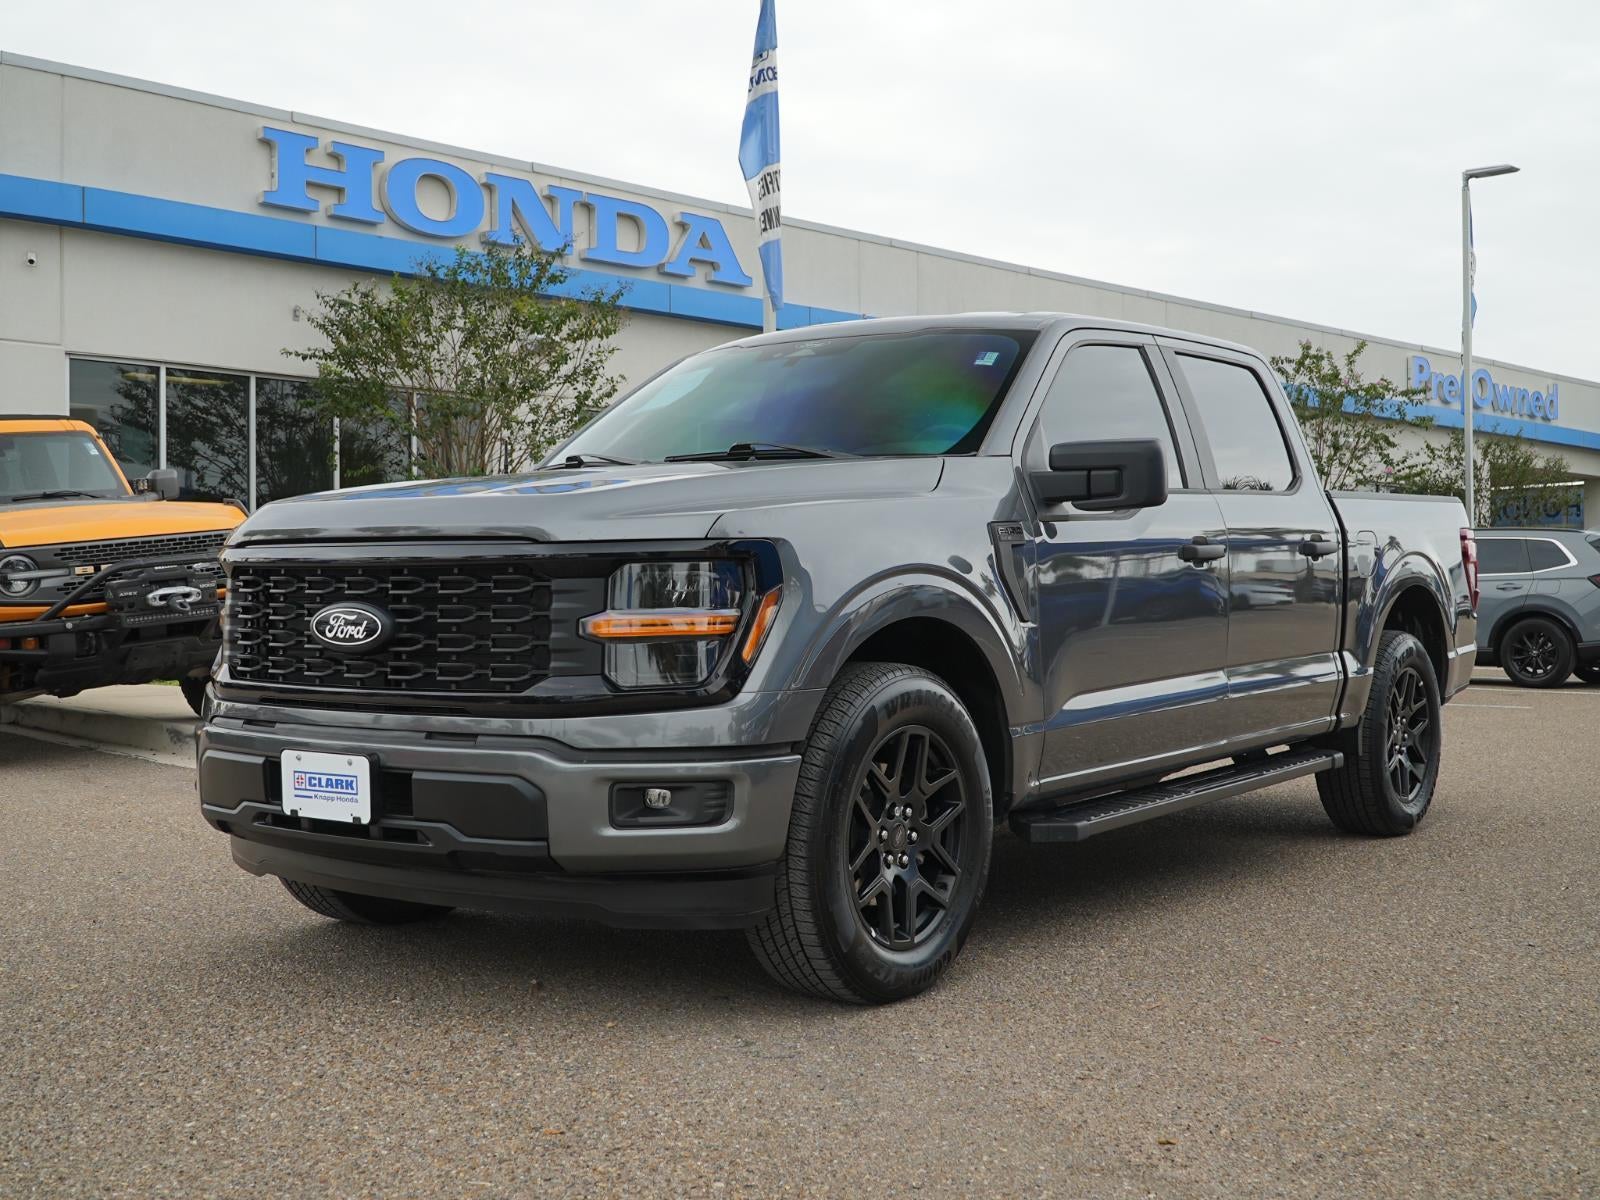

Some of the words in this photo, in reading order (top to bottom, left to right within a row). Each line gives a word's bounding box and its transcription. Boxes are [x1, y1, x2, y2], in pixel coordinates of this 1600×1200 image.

[258, 126, 752, 287] HONDA
[325, 613, 368, 639] Ford
[307, 776, 355, 791] CLARK
[314, 793, 336, 802] Knapp
[337, 796, 359, 804] Honda
